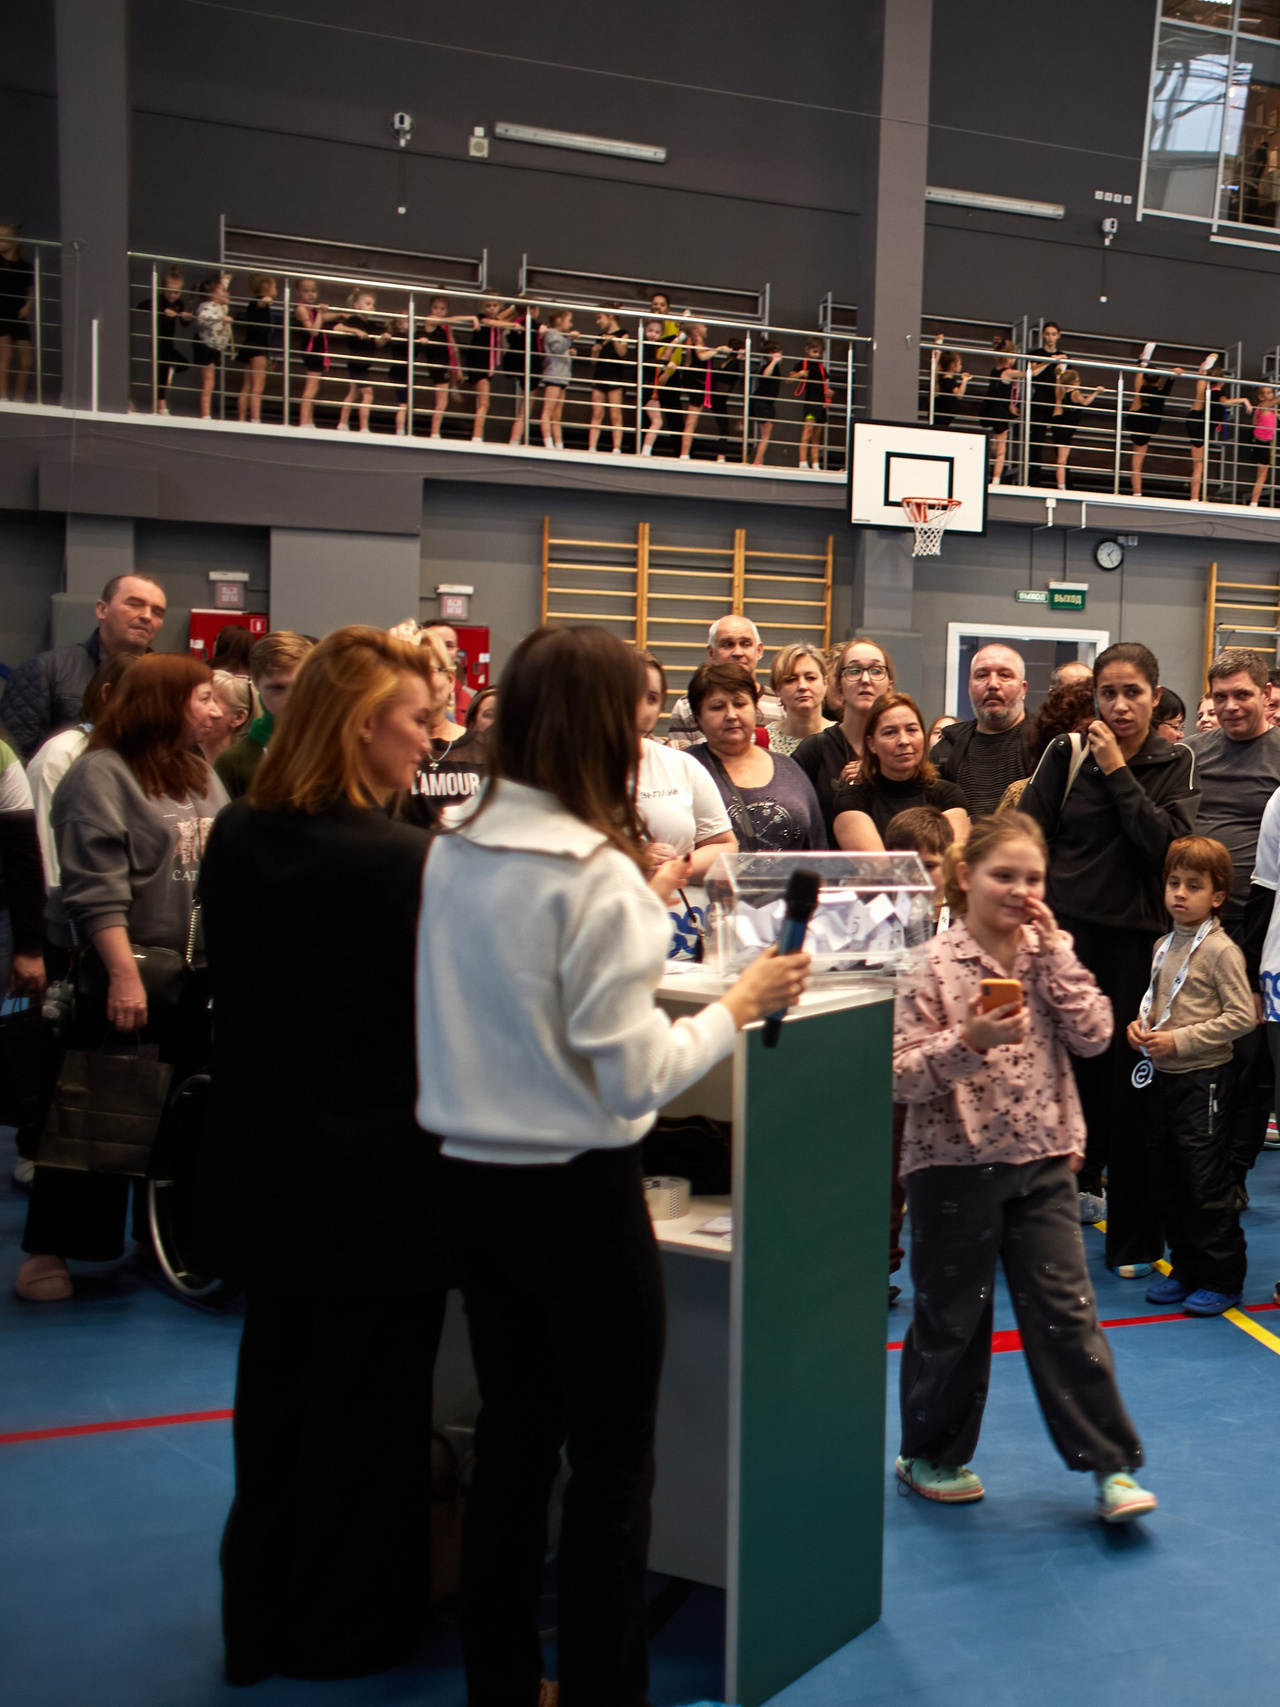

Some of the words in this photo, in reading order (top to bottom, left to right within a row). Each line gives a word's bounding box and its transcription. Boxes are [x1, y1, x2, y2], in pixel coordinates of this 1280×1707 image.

[1019, 592, 1046, 601] ВЫХОД
[1053, 594, 1082, 604] ВЫХОД
[401, 770, 482, 796] L'AMOUR
